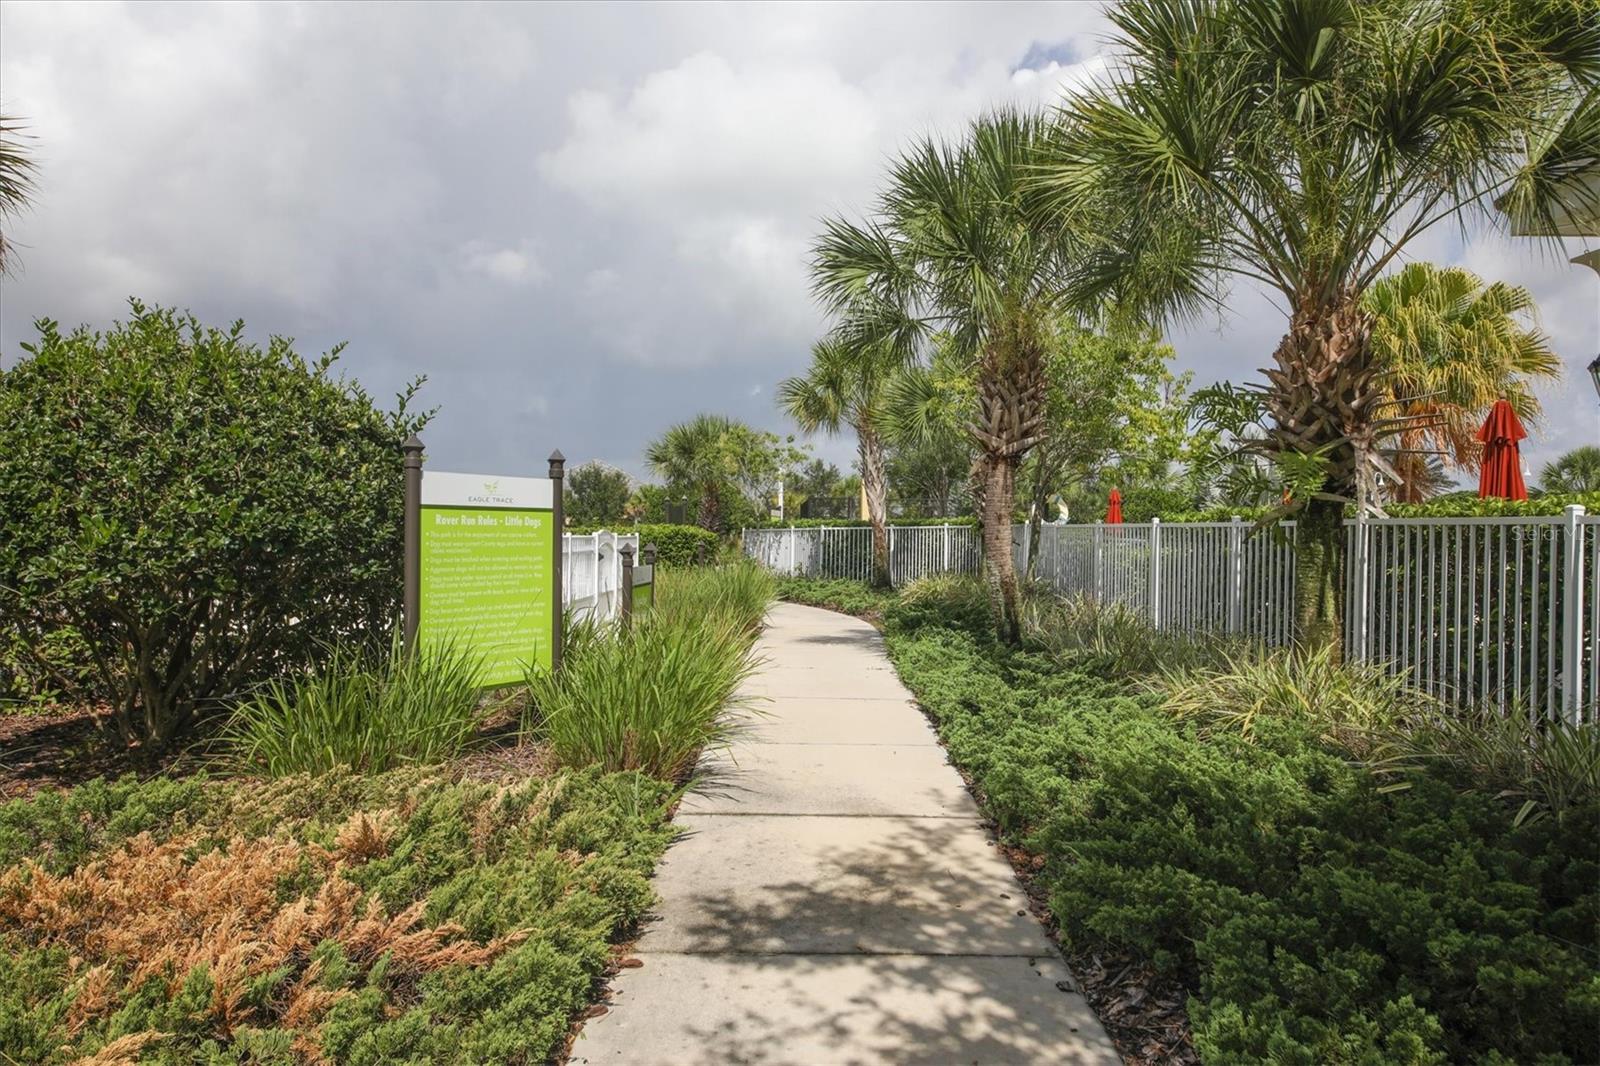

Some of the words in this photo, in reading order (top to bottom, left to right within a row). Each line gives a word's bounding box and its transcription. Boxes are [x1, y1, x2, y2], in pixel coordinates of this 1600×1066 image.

[436, 514, 459, 525] Rover
[461, 515, 476, 526] Run
[478, 515, 498, 526] Rules
[505, 516, 522, 526] Little
[524, 517, 541, 528] Dogs
